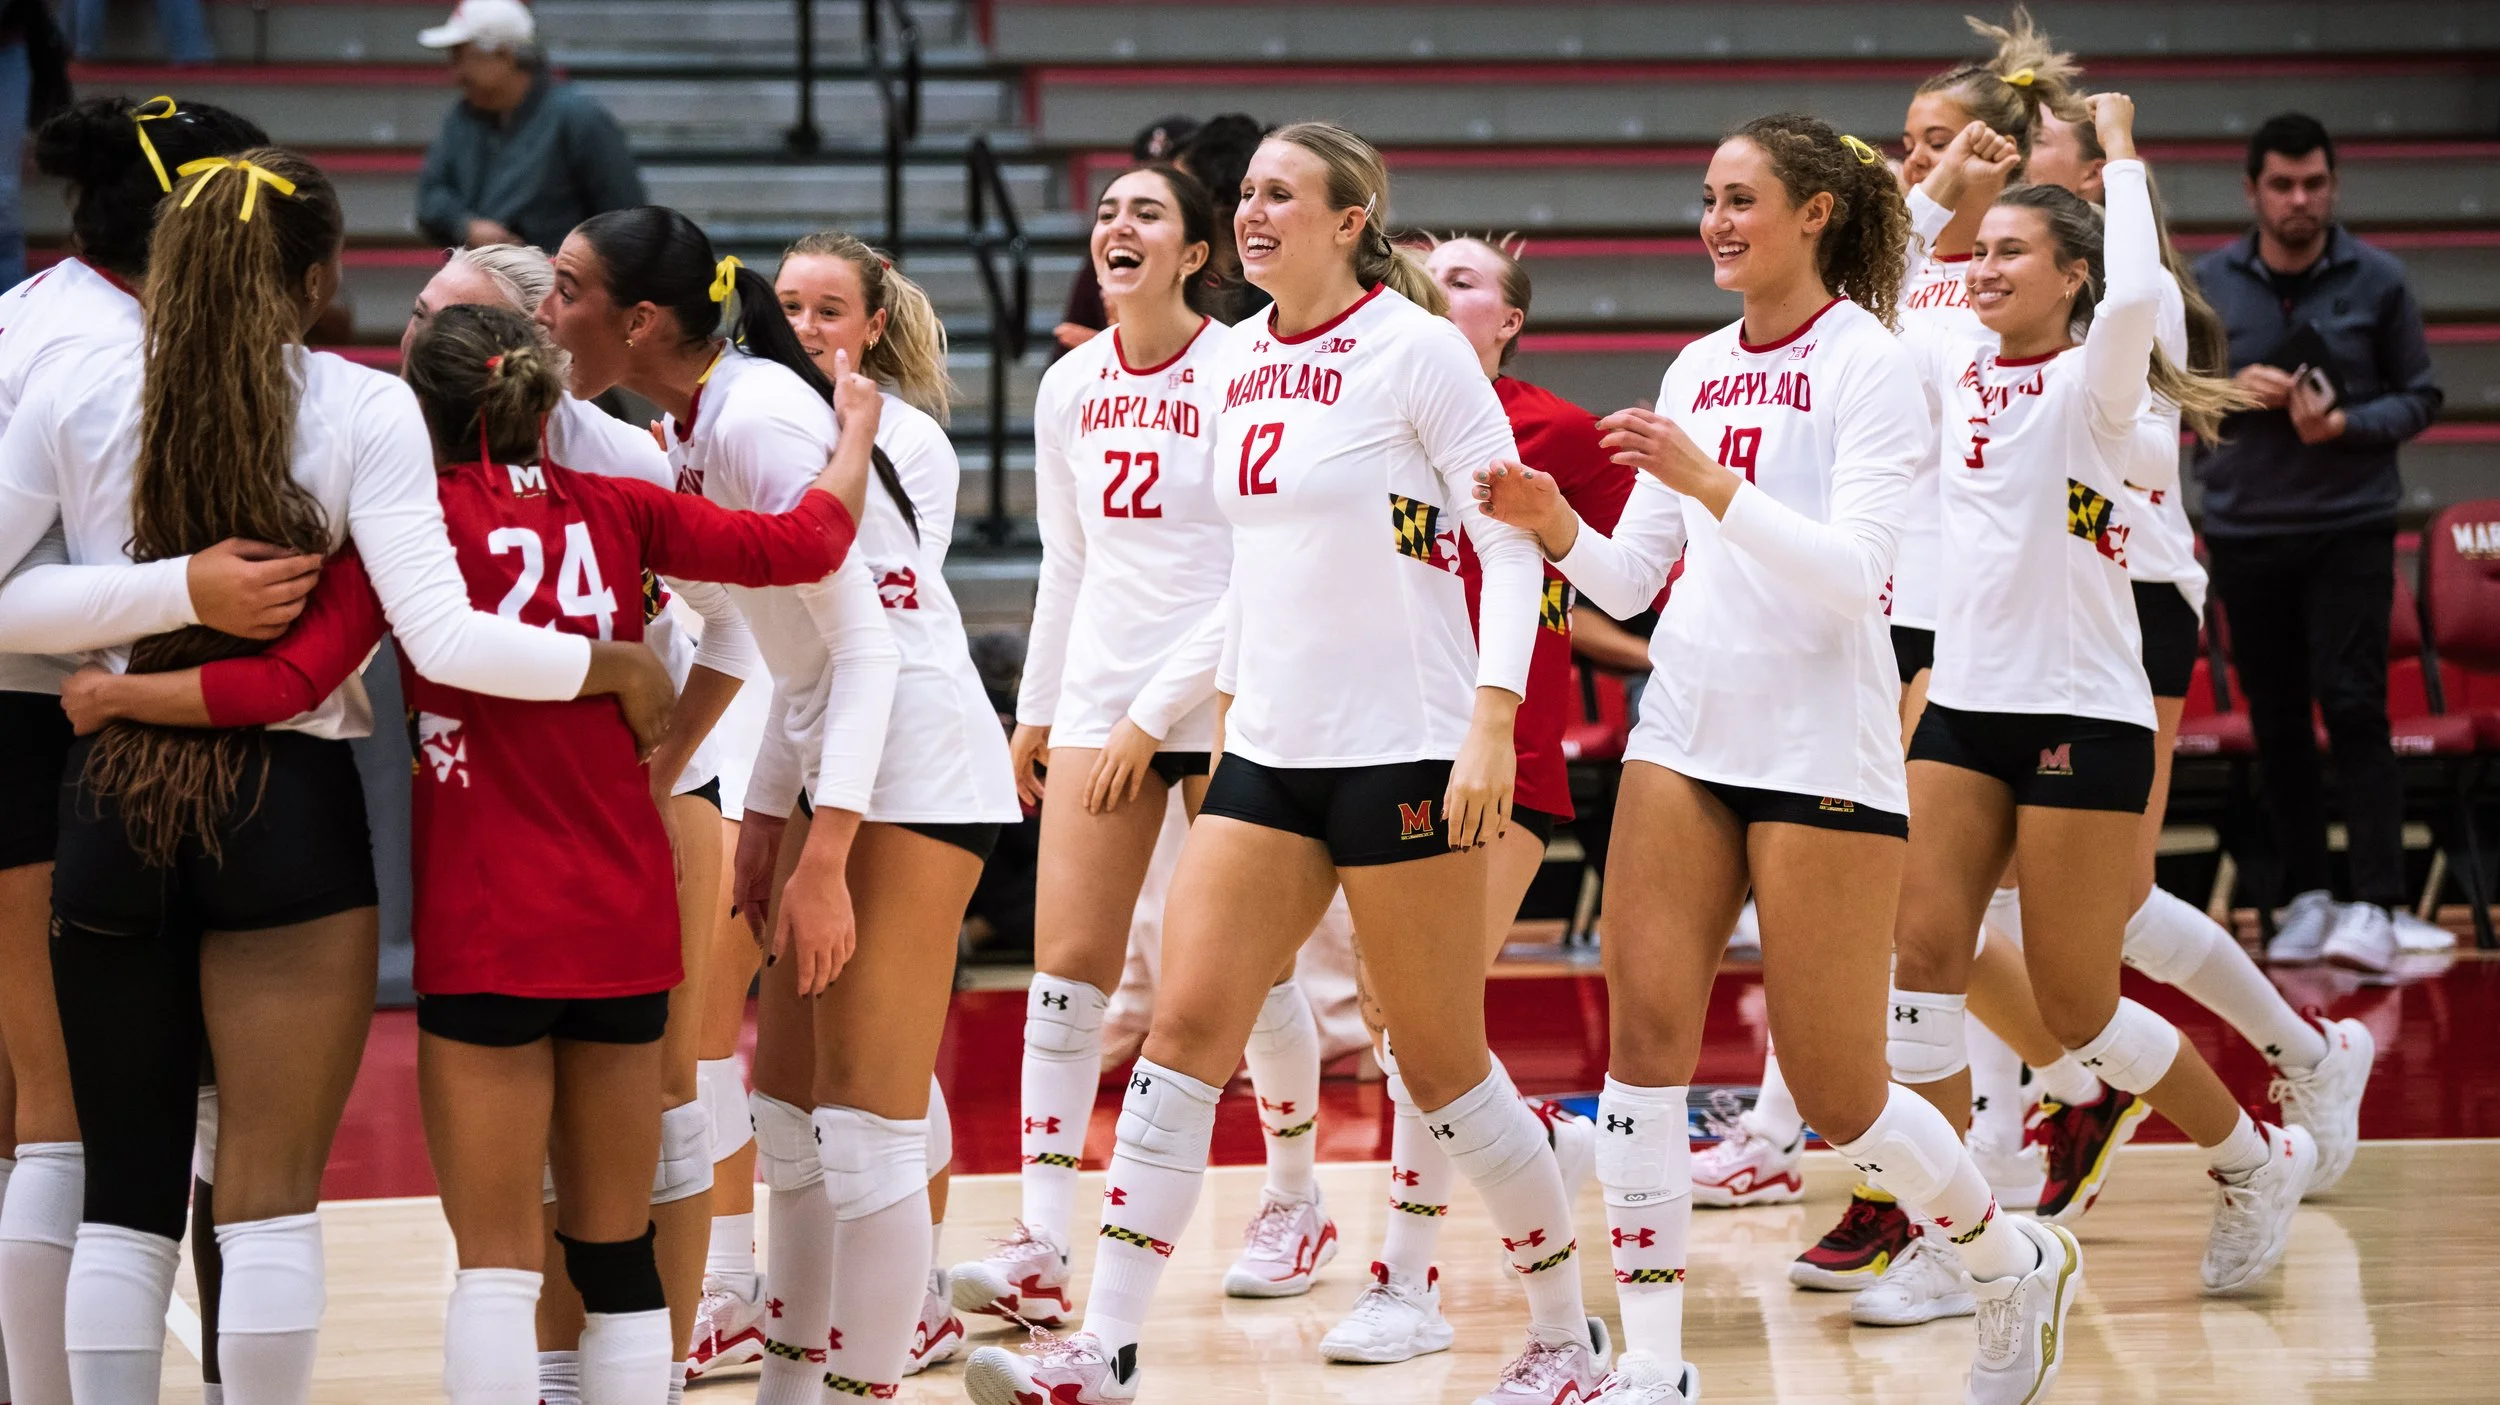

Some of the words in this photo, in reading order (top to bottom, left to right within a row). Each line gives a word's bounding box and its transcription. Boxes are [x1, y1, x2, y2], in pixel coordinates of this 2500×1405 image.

[1222, 363, 1342, 414] MARYLAND
[1691, 372, 1812, 414] MARYLAND
[1081, 396, 1199, 438] MARYLAND
[506, 464, 548, 493] M
[1238, 422, 1285, 496] 12
[1717, 425, 1762, 487] 19
[1103, 450, 1162, 518] 22
[487, 521, 618, 641] 24
[2037, 743, 2073, 770] M
[1398, 800, 1434, 836] M
